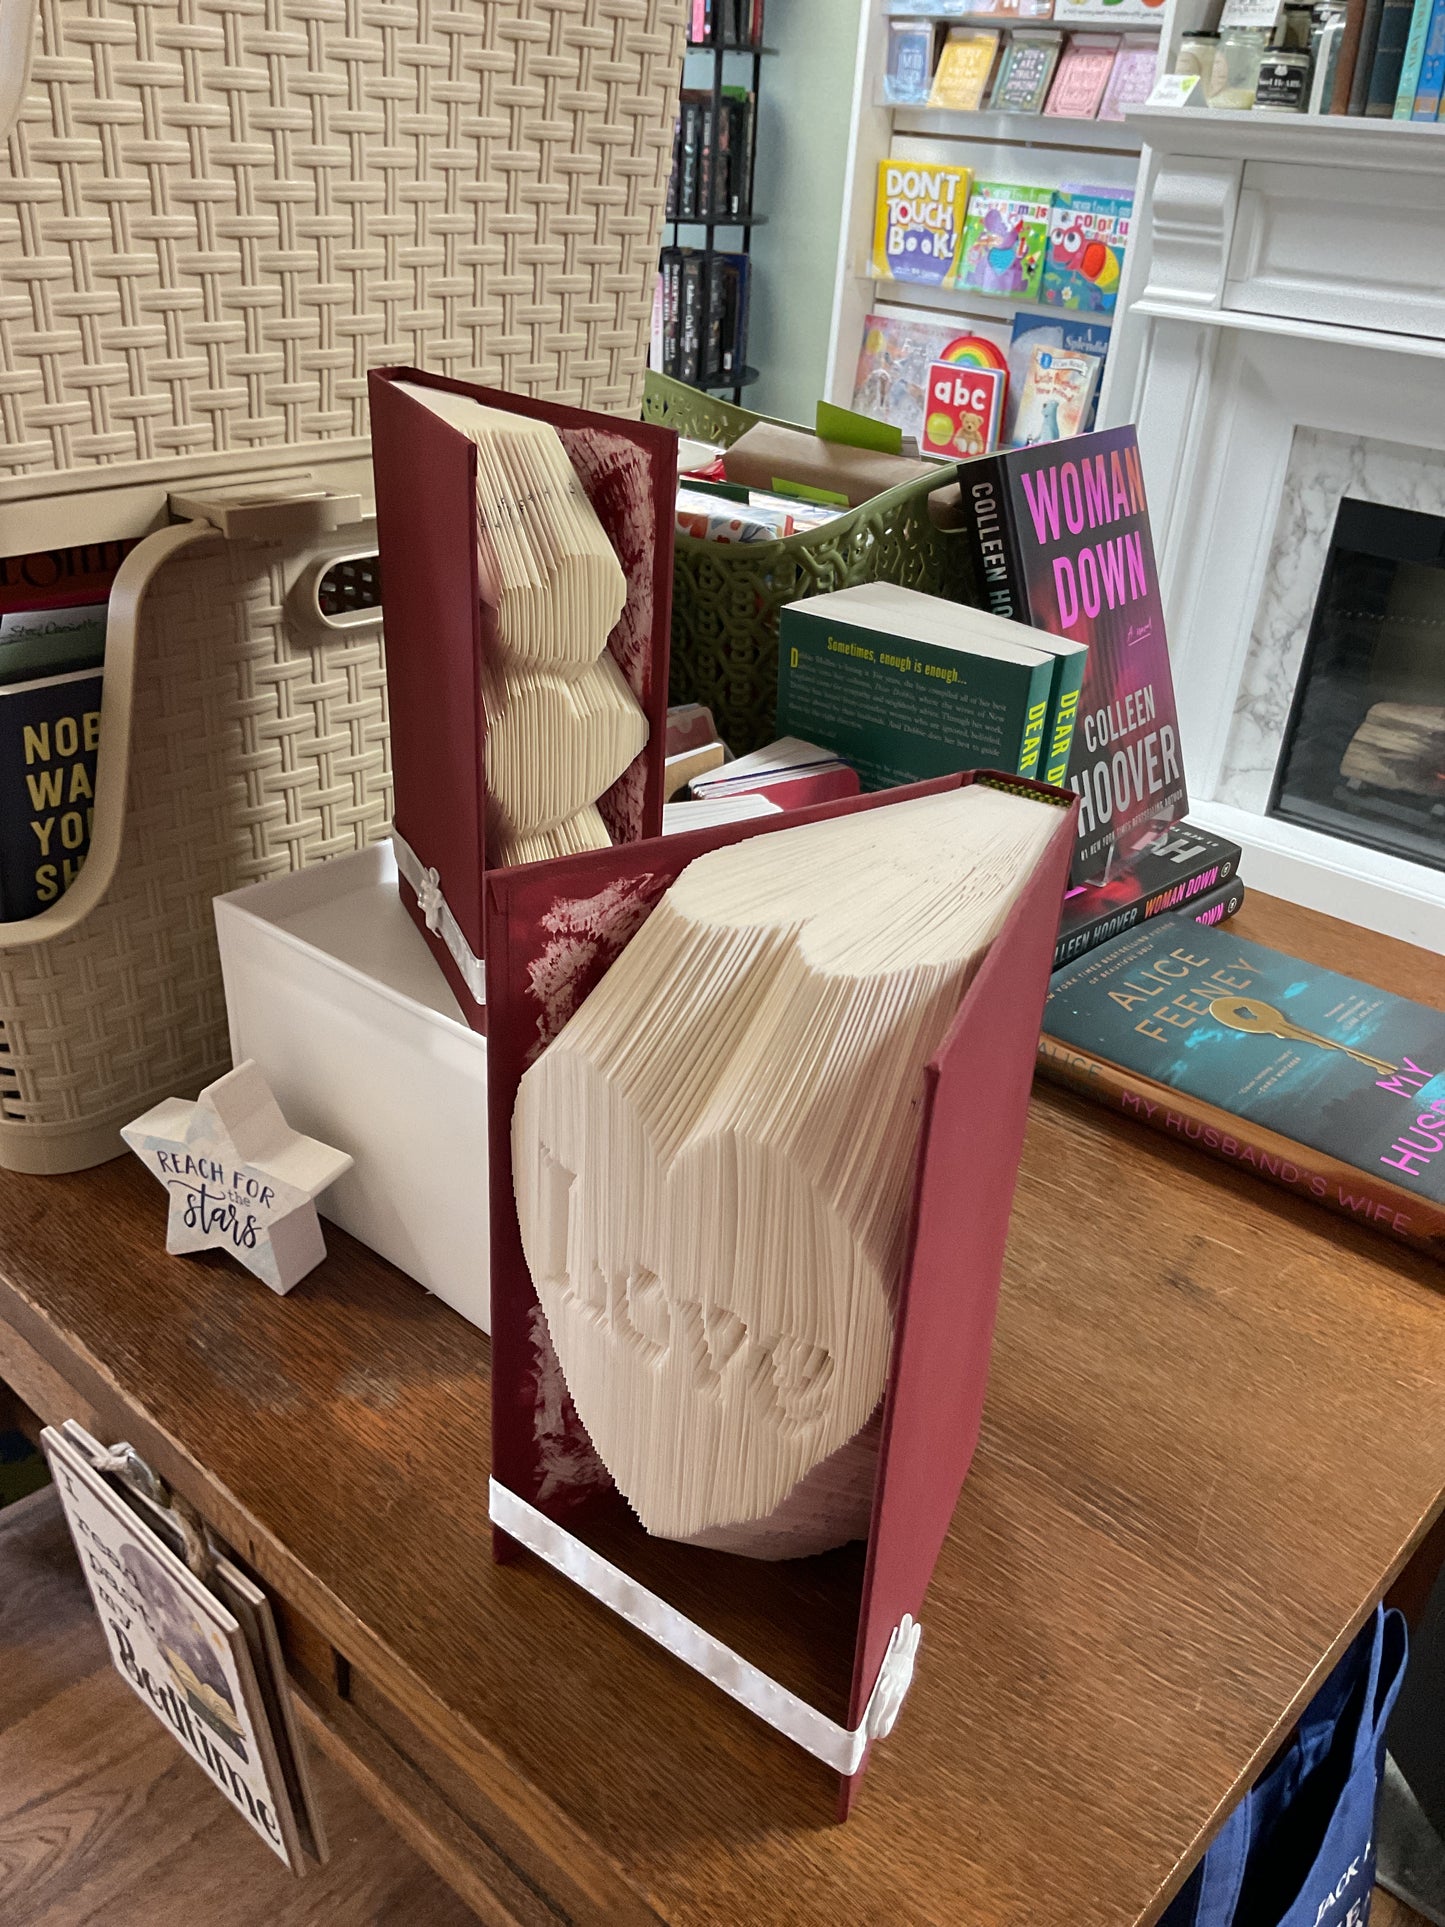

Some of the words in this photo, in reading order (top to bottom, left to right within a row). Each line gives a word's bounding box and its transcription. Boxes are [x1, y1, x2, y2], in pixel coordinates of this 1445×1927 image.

[886, 169, 961, 203] DON'T
[886, 199, 954, 231] TOUCH
[934, 377, 987, 412] abc
[1020, 446, 1145, 545] WOMAN
[971, 482, 1008, 583] COLLEEN
[1052, 530, 1147, 629] DOWN
[827, 636, 876, 665] Sometimes,
[879, 651, 911, 673] enough
[913, 658, 922, 674] is
[1020, 701, 1047, 771] DEAR
[1050, 689, 1079, 758] DEAR
[1083, 684, 1156, 753] COLLEEN
[1070, 724, 1180, 838] HOOVER
[1092, 907, 1139, 942] HOOVER
[1144, 882, 1186, 919] WOMAN
[1185, 865, 1219, 898] DOWN
[1056, 976, 1079, 993] YORK
[1078, 962, 1103, 979] TIMES
[1108, 947, 1211, 1012] ALICE
[1134, 957, 1264, 1044] FEENEY
[1375, 1056, 1434, 1099] MY
[156, 1149, 225, 1185] REACH
[233, 1171, 276, 1210] FOR
[227, 1188, 252, 1208] the
[1121, 1090, 1159, 1119] MY
[1165, 1111, 1328, 1198] HUSBAND'S
[1337, 1185, 1412, 1237] WIFE
[175, 1182, 263, 1250] stars
[109, 1618, 282, 1847] Bedtime
